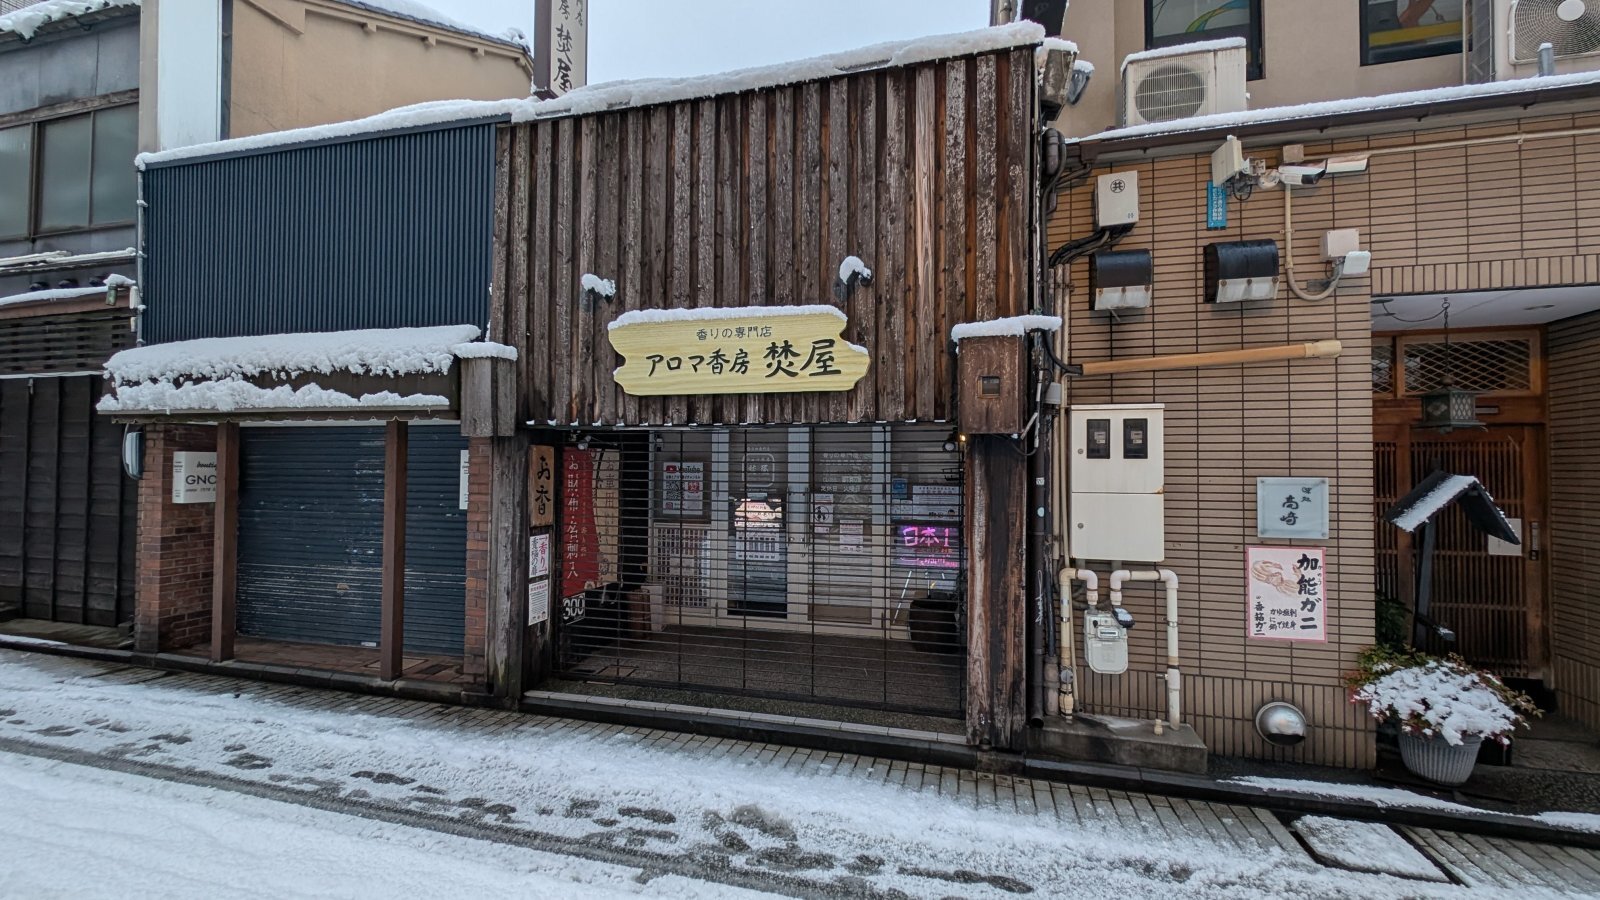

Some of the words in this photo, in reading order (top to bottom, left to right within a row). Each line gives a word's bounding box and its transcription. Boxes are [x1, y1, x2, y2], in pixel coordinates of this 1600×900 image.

[646, 348, 750, 377] アロマ香房
[763, 338, 842, 378] 焚屋
[697, 325, 773, 341] 香りの専門店
[535, 455, 551, 516] お香
[1297, 553, 1322, 630] 加能ガニ
